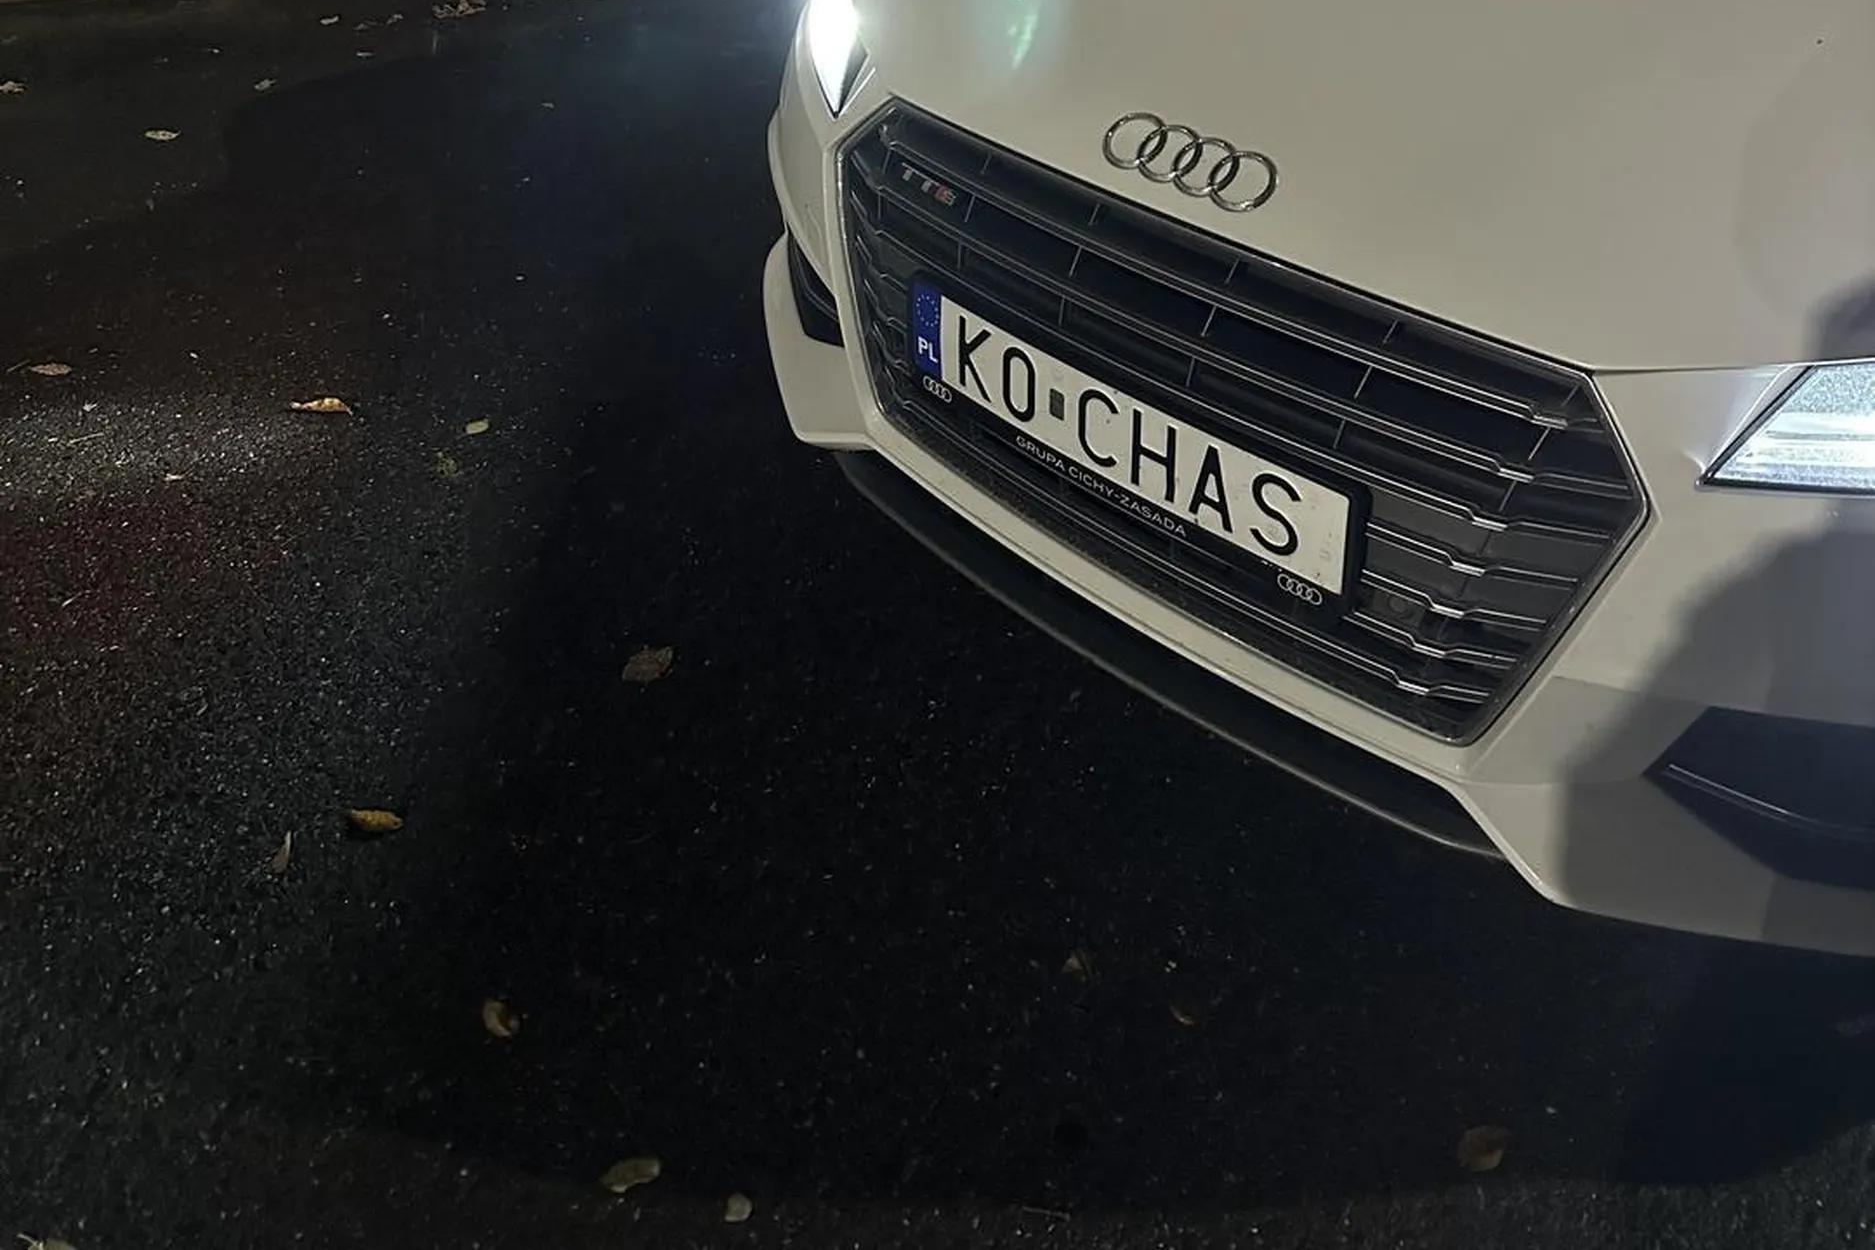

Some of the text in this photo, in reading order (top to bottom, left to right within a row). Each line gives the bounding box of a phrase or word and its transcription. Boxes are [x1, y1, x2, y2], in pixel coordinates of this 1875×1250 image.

[917, 335, 938, 364] PL
[1015, 434, 1188, 538] GRUPA CICHY-ZASADA
